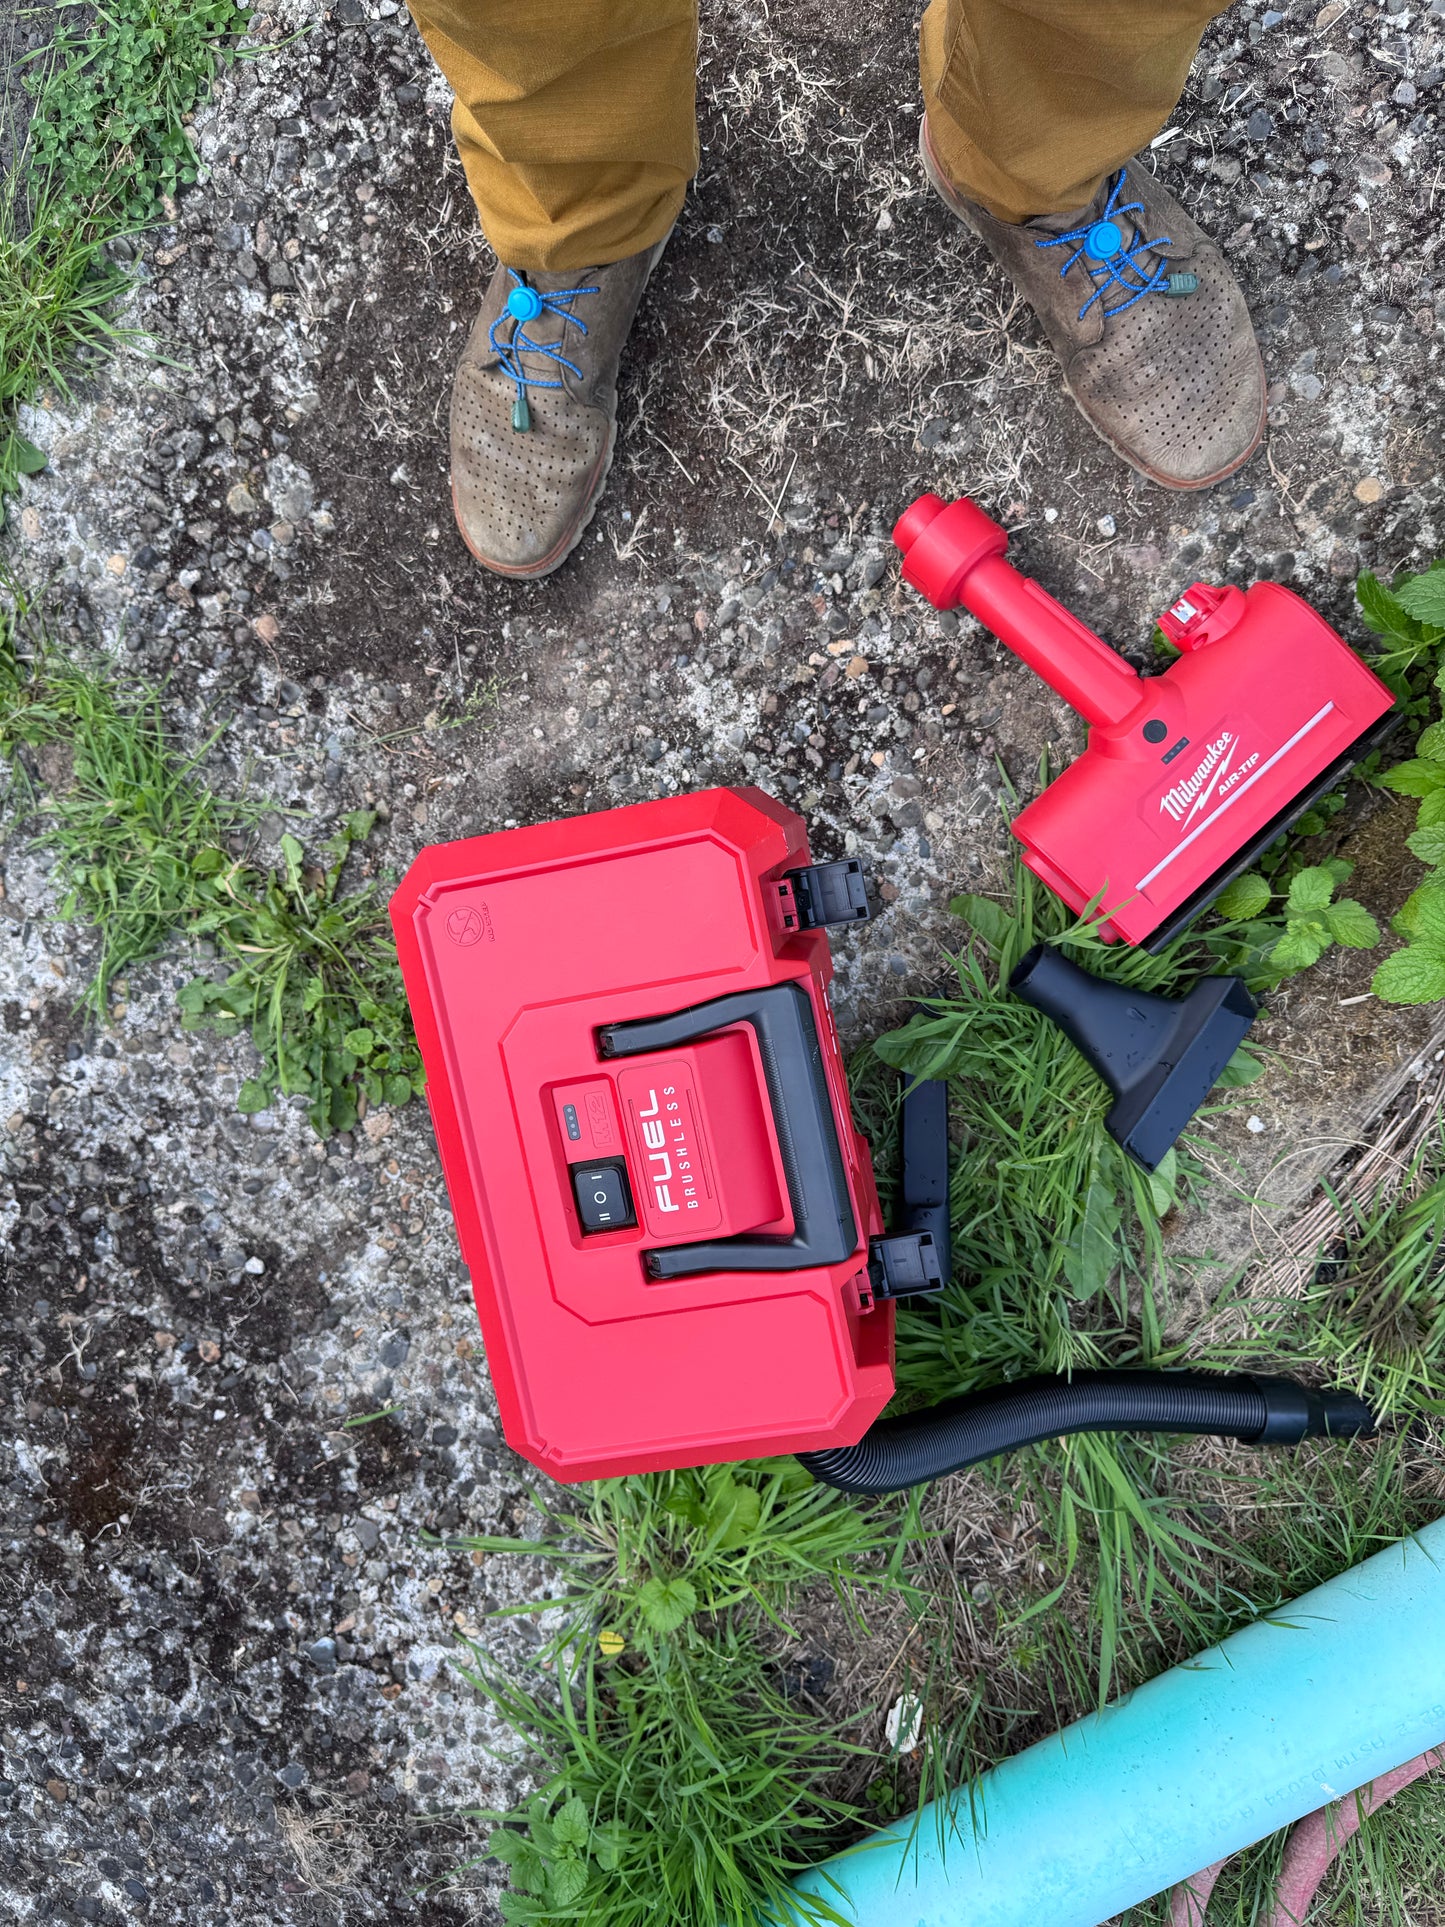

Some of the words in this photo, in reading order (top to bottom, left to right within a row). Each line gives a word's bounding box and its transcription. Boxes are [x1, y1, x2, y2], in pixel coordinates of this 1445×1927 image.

[1160, 732, 1233, 821] Milwaukee
[1217, 752, 1260, 796] AIR-TIP
[588, 1094, 611, 1145] M12
[639, 1089, 680, 1213] FUEL
[663, 1086, 699, 1209] BRUSHLESS
[1333, 1735, 1386, 1770] ASTM
